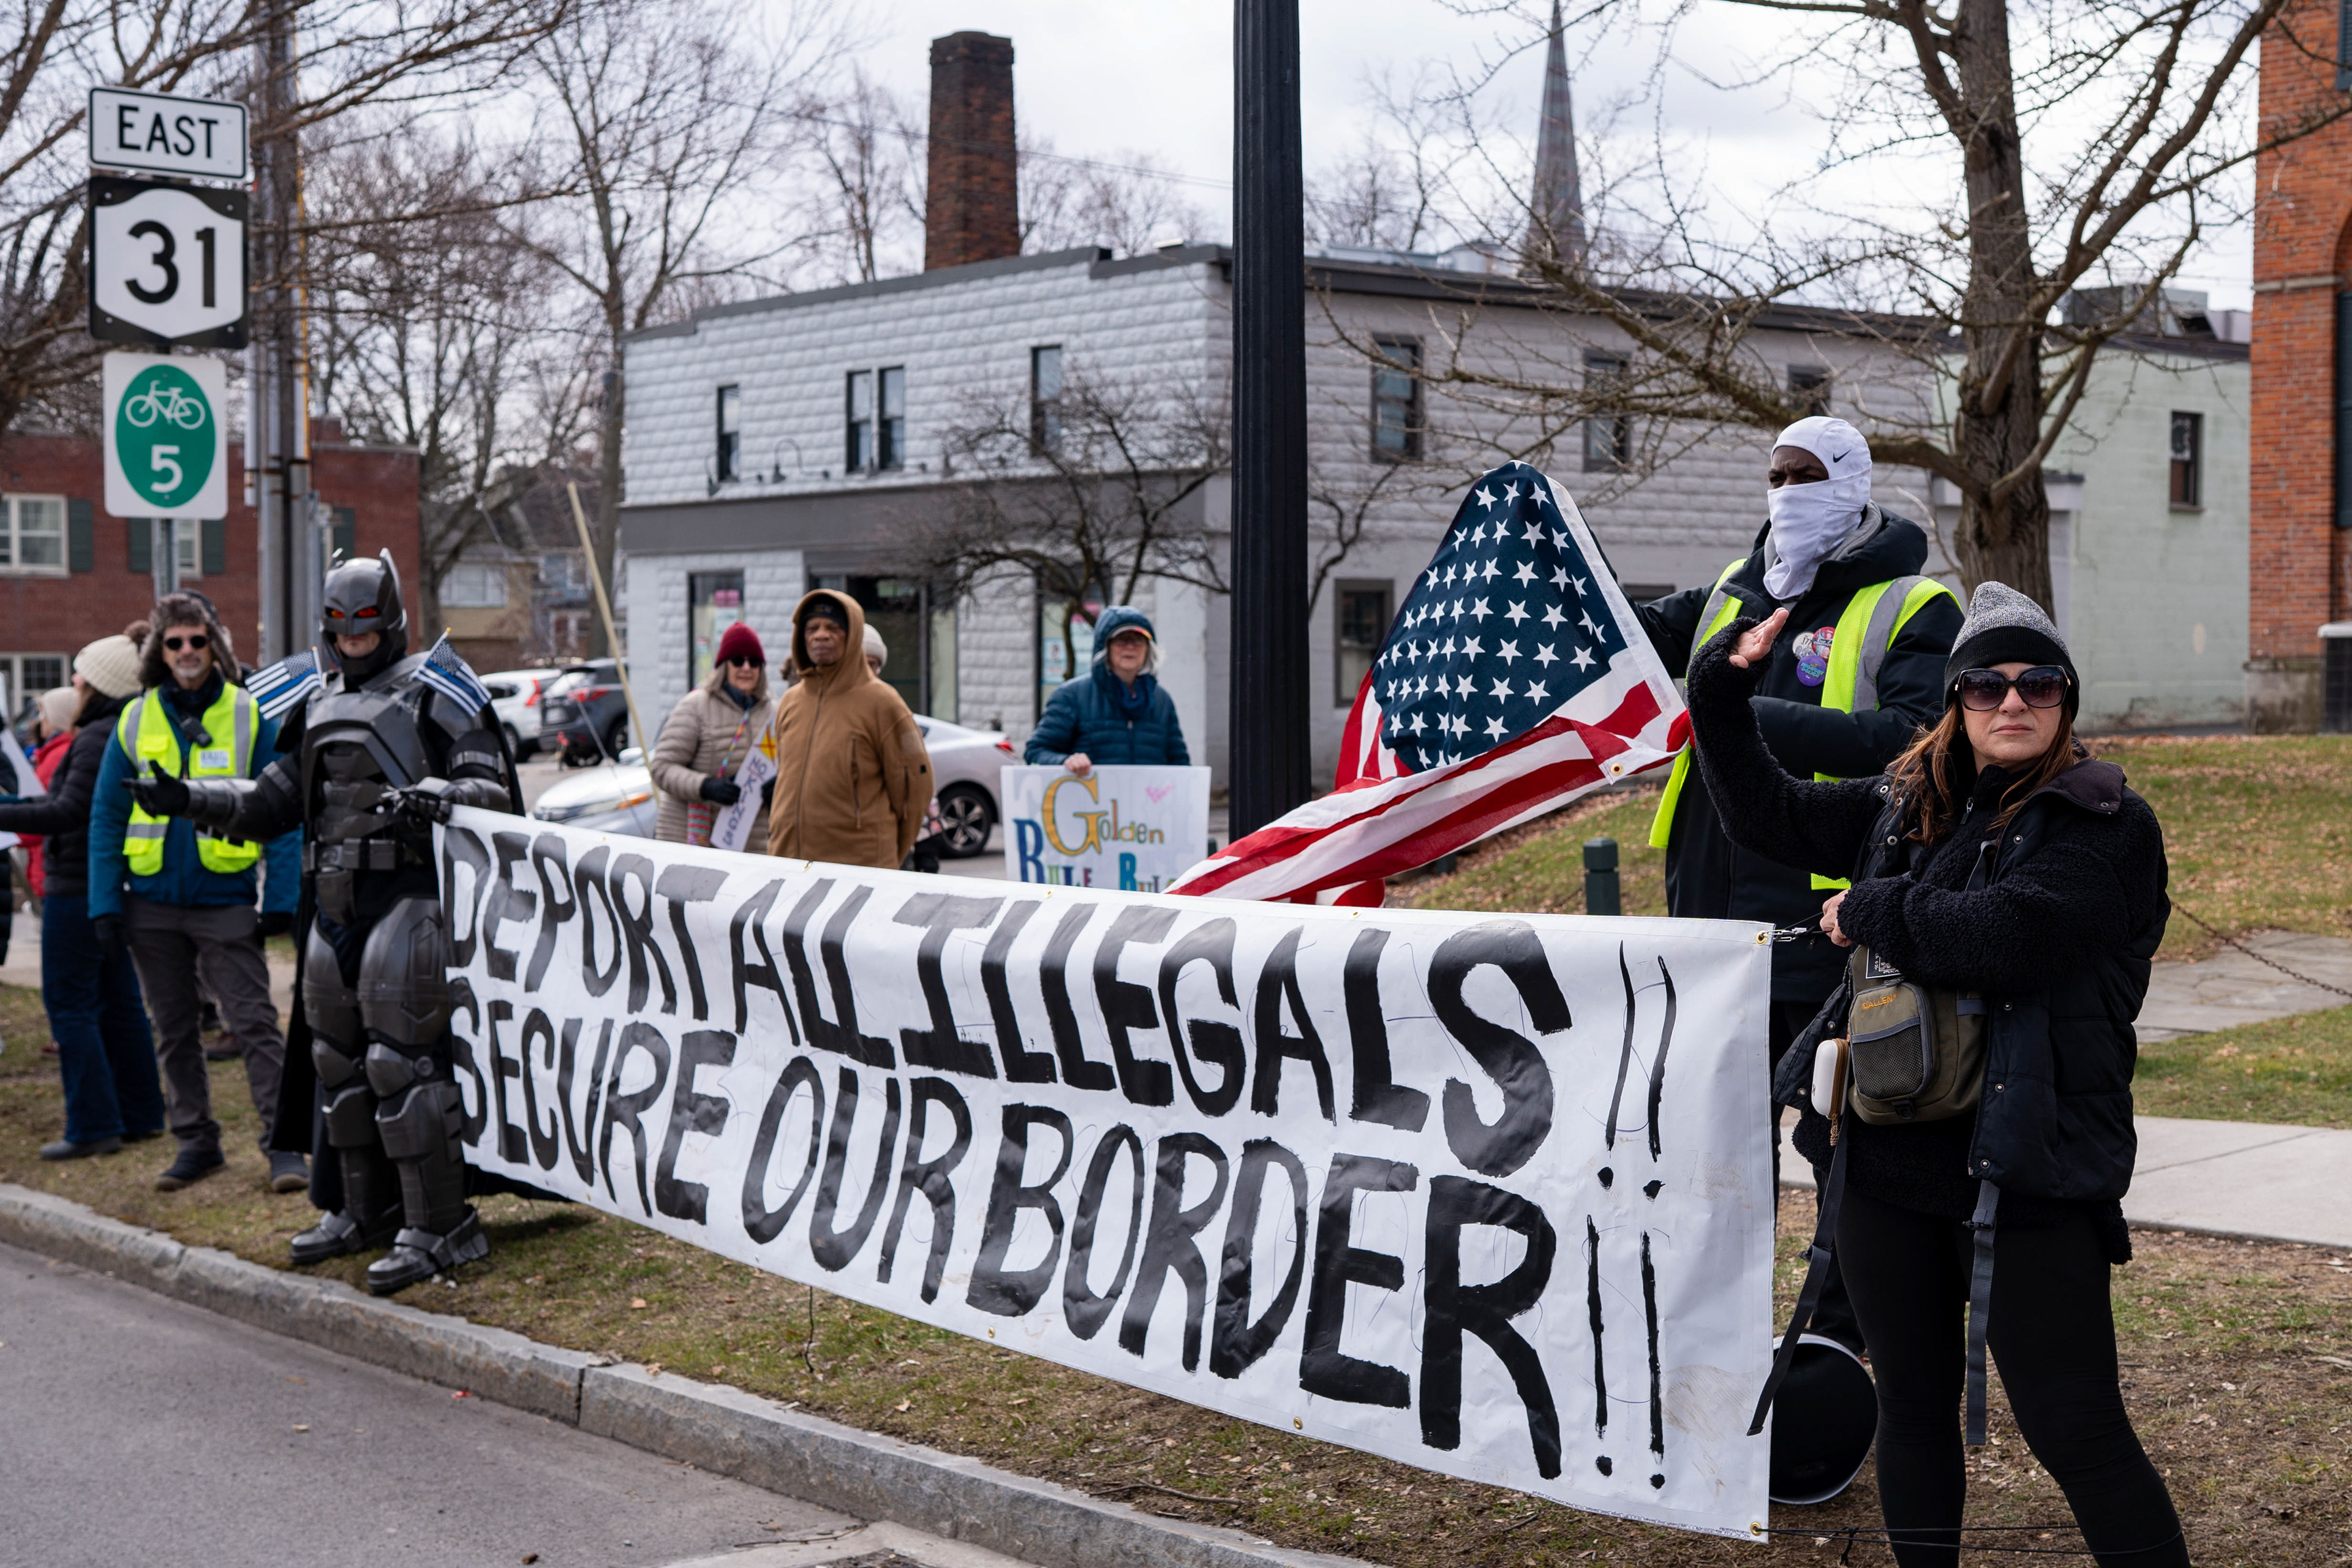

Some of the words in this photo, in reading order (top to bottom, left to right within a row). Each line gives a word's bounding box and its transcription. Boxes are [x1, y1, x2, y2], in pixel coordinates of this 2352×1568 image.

[118, 105, 219, 159] EAST
[125, 220, 216, 309] 31
[150, 445, 183, 494] 5
[1043, 773, 1164, 856] Golden
[443, 825, 729, 1020] DEPORT
[731, 878, 895, 1068] ALL
[449, 977, 736, 1224] SECURE
[743, 1056, 972, 1305] OUR
